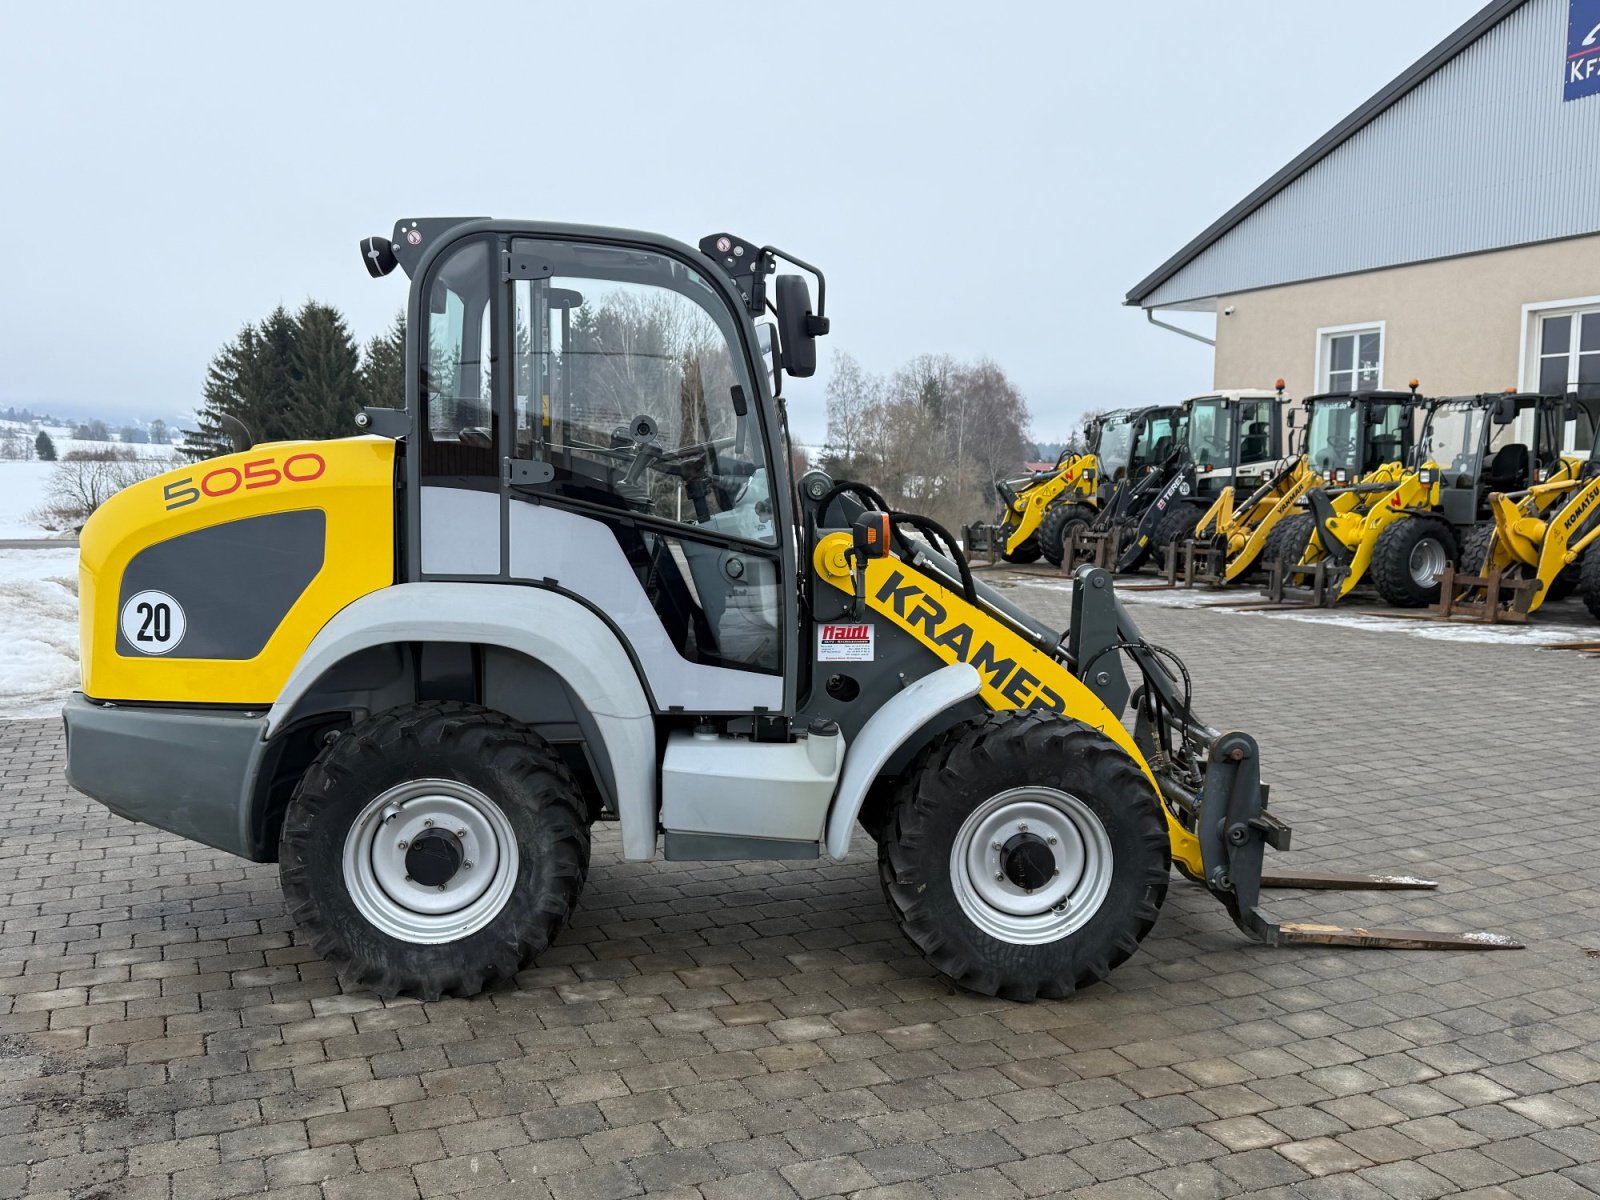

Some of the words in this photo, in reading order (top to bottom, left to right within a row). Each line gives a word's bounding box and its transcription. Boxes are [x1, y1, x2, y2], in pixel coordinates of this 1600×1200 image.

[1570, 57, 1600, 83] KF
[163, 453, 326, 511] 5050
[1163, 472, 1185, 500] TEREX
[1277, 484, 1303, 513] YANMAR
[1564, 486, 1600, 530] KOMATSU
[137, 602, 171, 642] 20
[875, 570, 1066, 713] KRAMER
